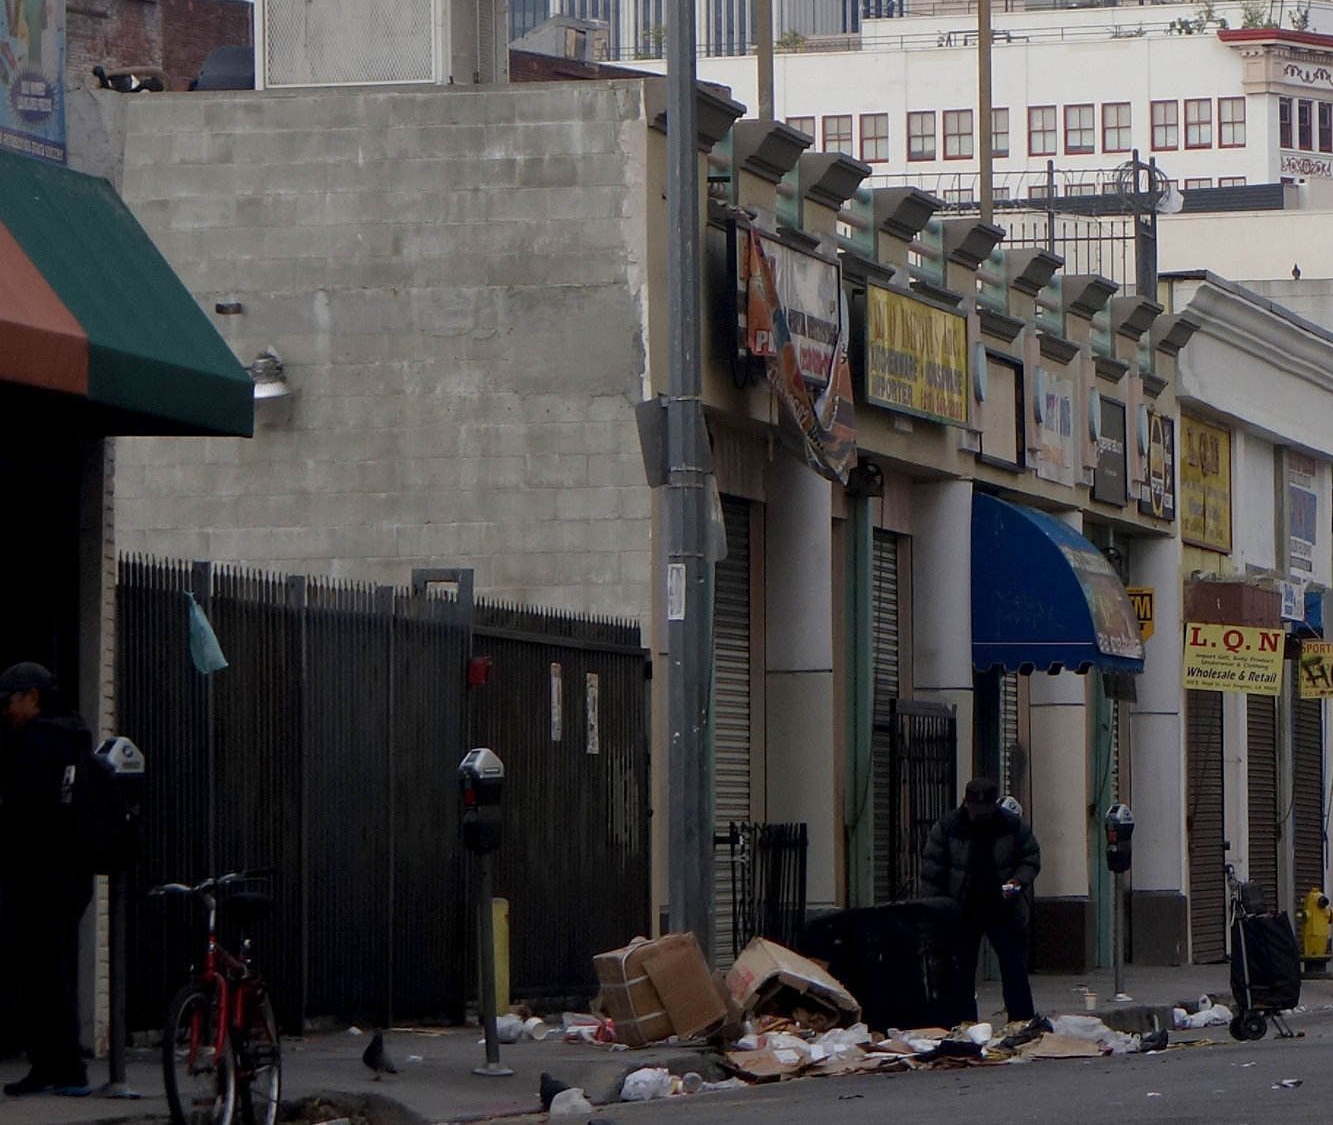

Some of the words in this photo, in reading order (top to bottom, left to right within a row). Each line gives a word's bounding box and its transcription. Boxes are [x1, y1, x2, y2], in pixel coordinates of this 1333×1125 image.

[1201, 659, 1235, 667] Underwear
[1243, 662, 1269, 670] Clothing
[1187, 666, 1236, 681] Wholesale
[1238, 670, 1246, 681] &
[1248, 671, 1277, 683] Retail
